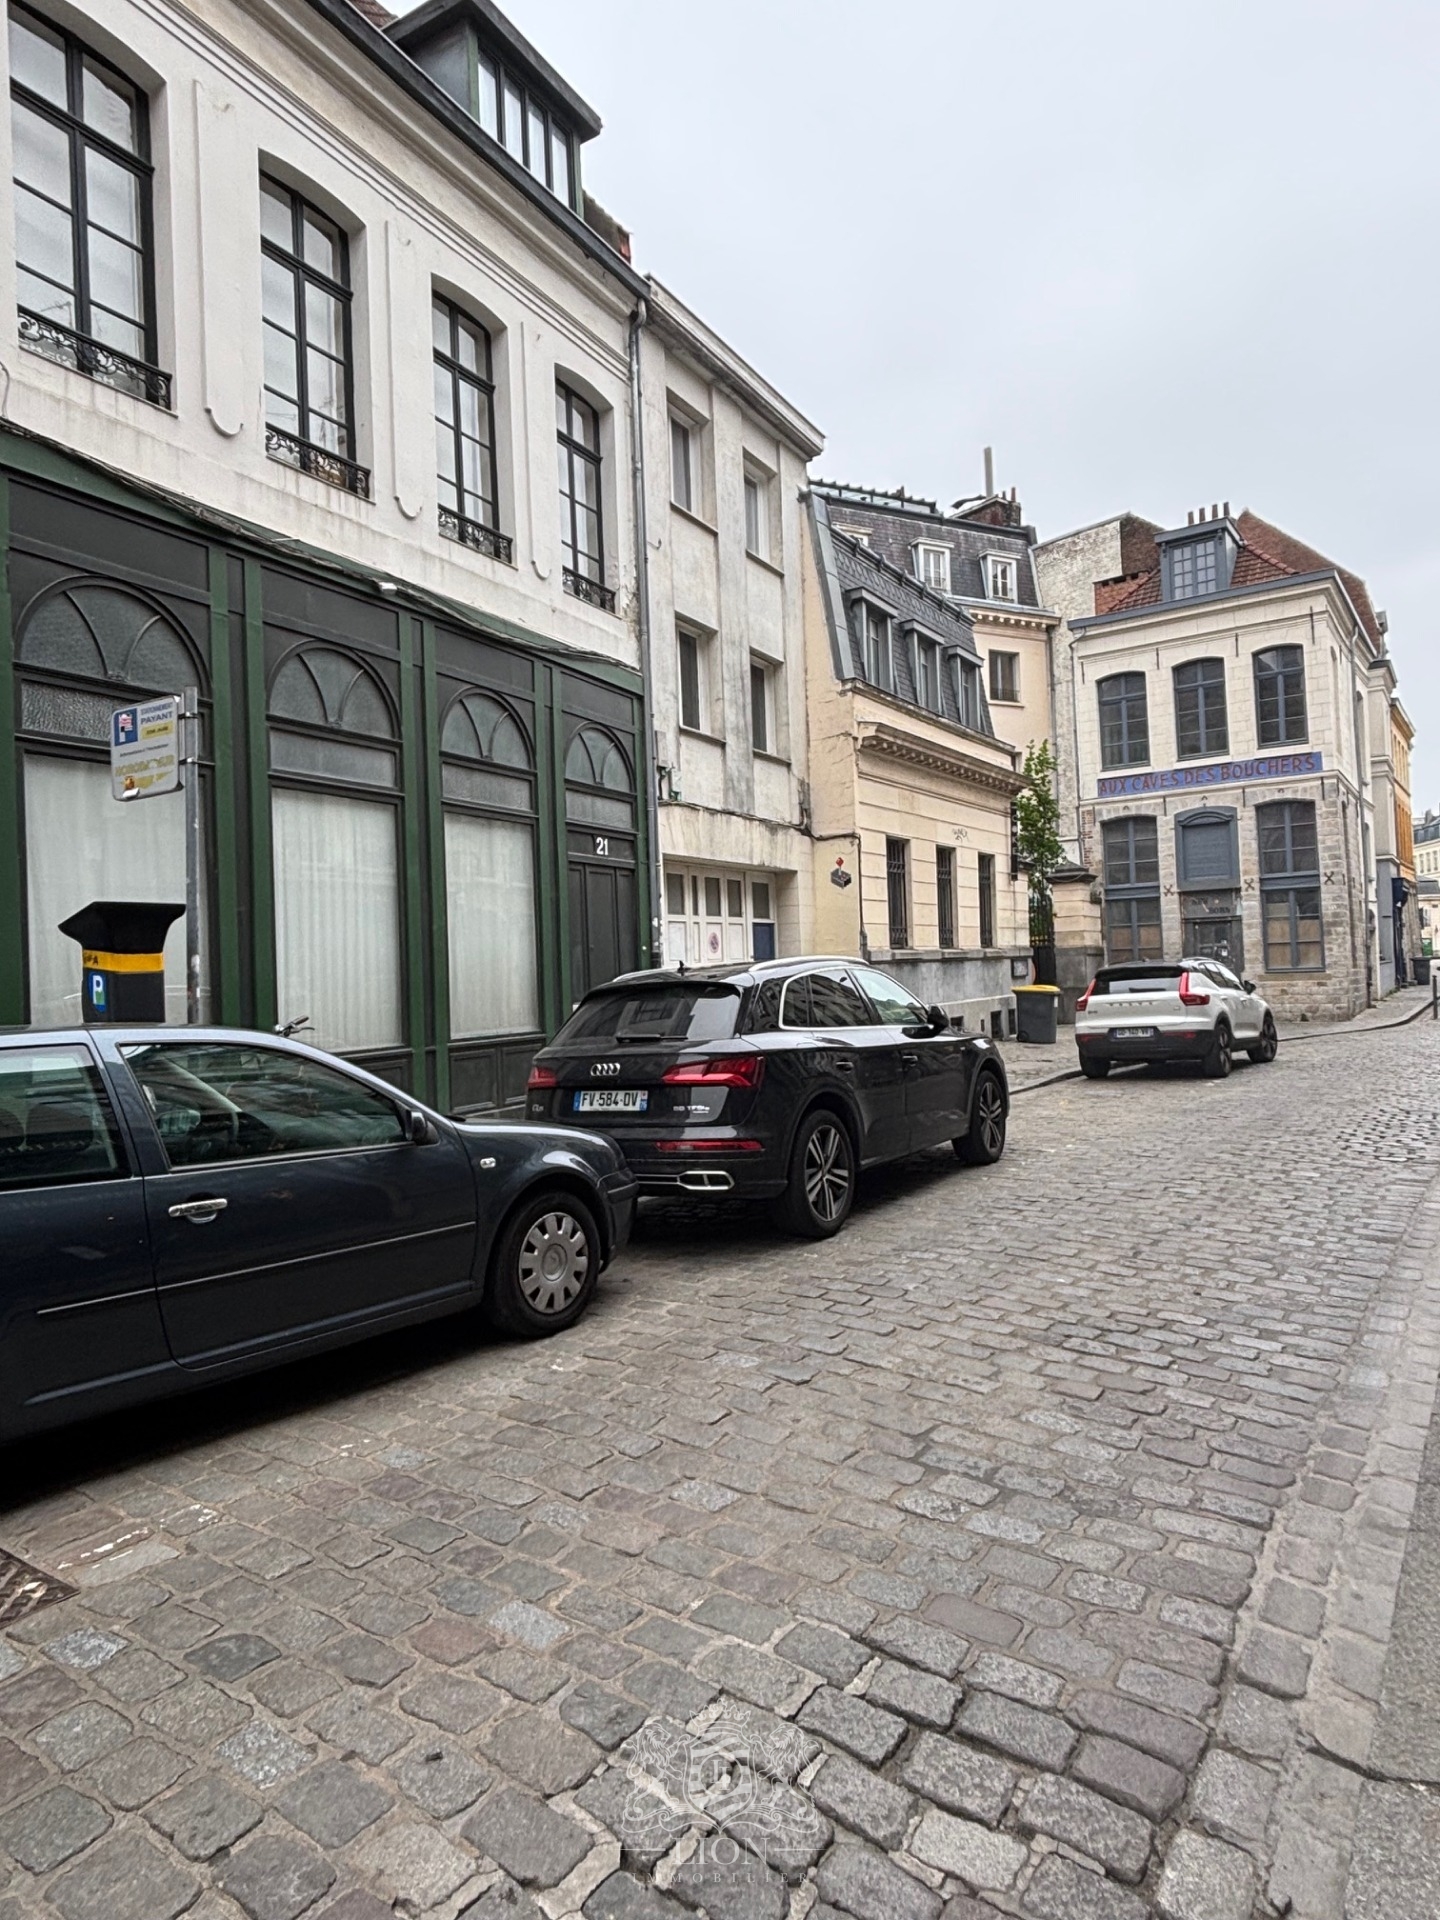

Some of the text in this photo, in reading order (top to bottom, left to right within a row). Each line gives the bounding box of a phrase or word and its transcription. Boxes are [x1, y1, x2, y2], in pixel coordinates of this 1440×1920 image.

[141, 711, 173, 724] PAYANT
[1100, 755, 1316, 794] AUX CAVES DES BOUCHERS
[596, 836, 608, 855] 21
